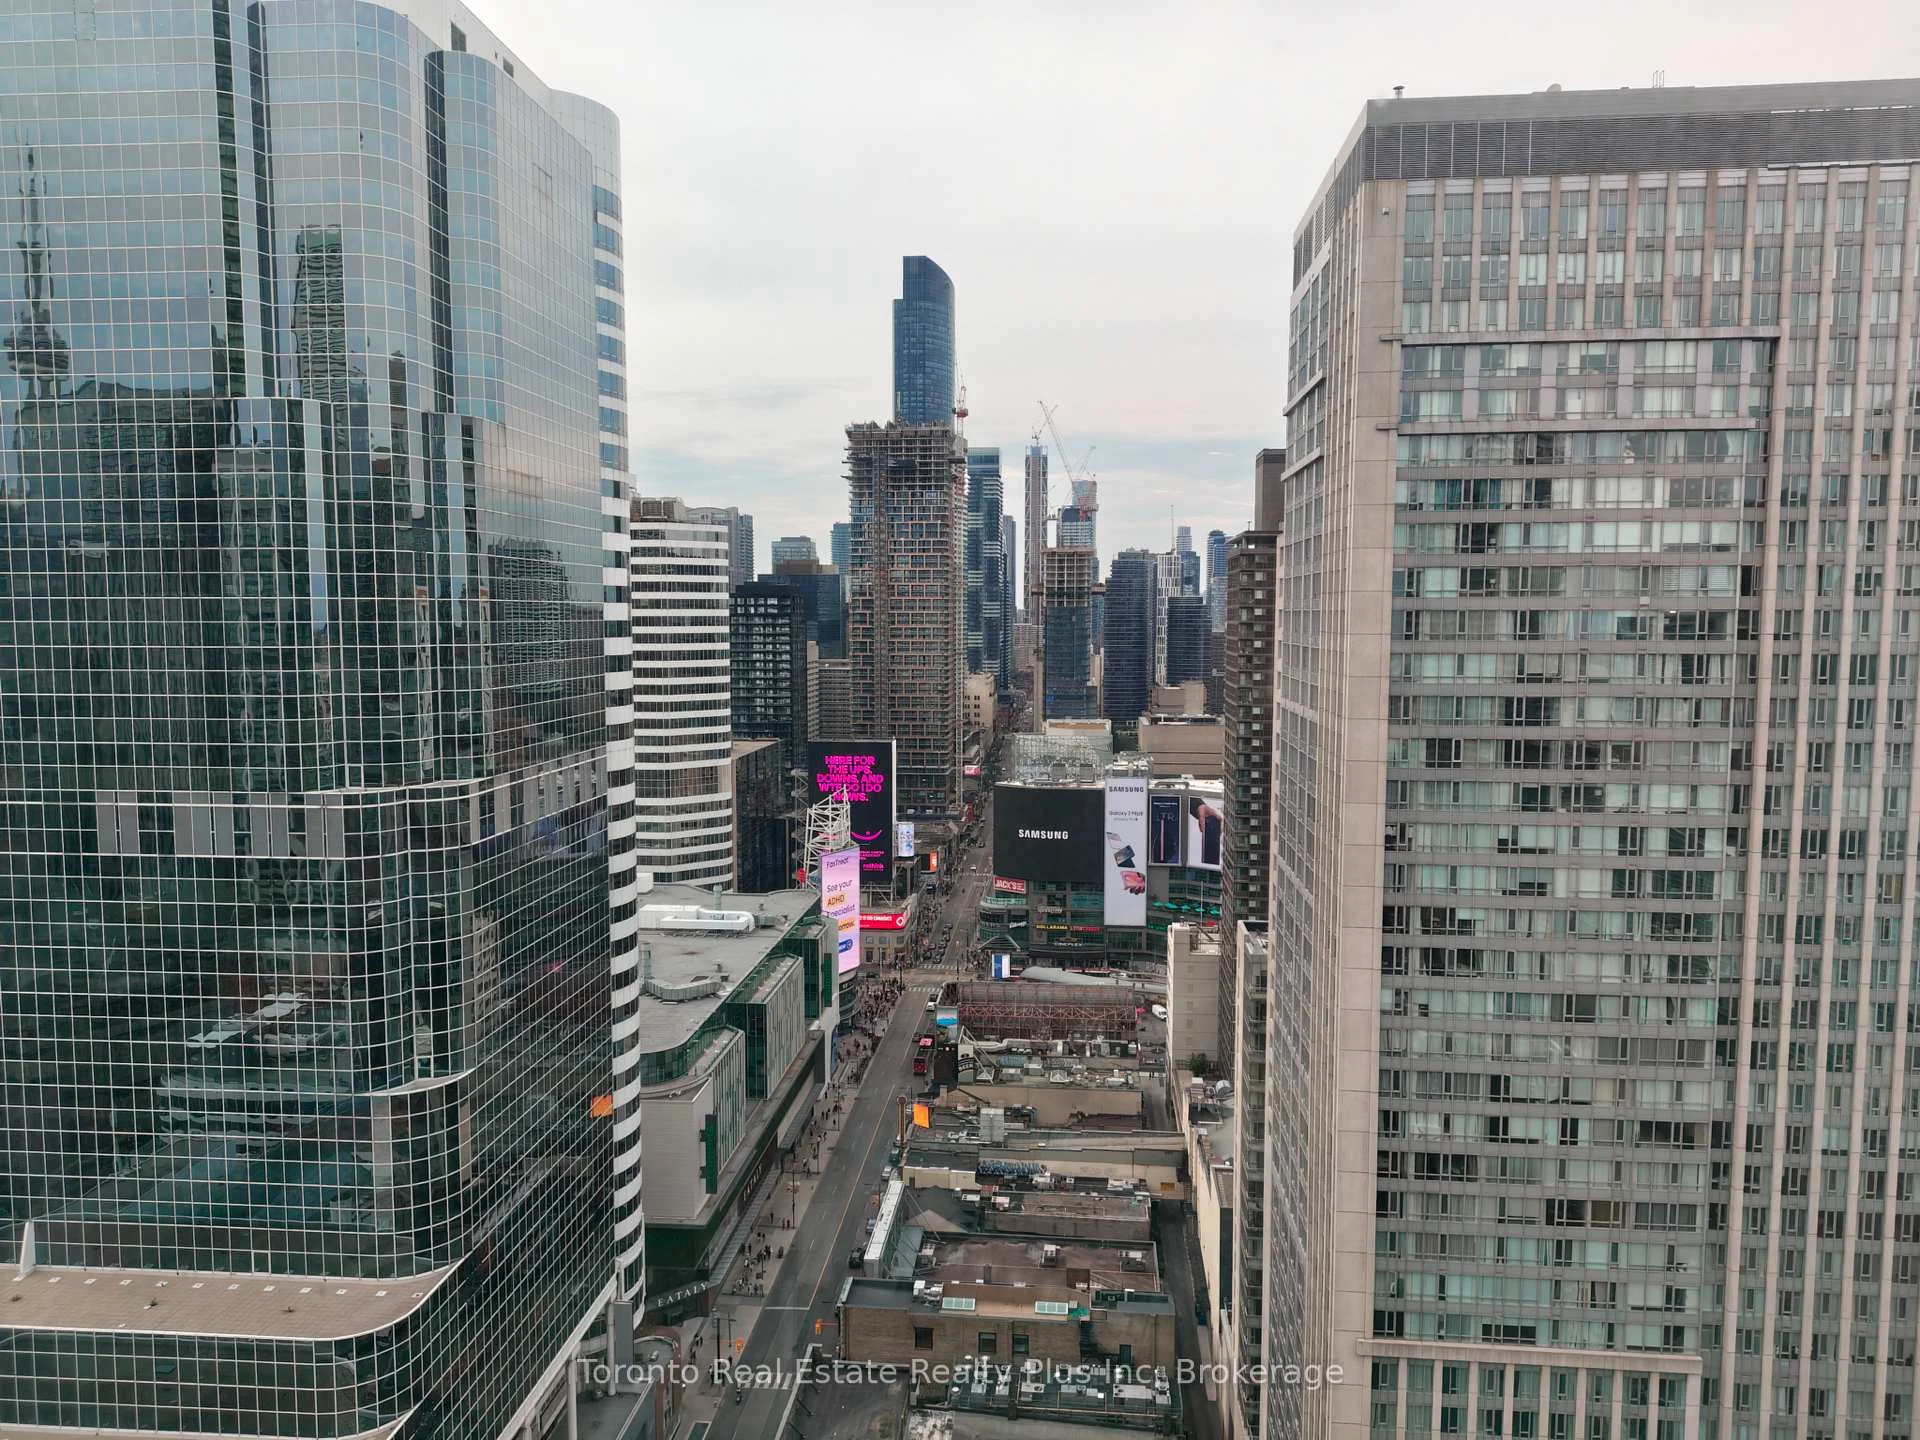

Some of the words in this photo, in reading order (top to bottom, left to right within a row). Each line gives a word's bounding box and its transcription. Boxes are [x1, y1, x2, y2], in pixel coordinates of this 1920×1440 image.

[825, 755, 853, 766] HERE
[853, 755, 876, 766] FOR
[827, 765, 849, 775] THE
[860, 774, 884, 784] AND
[865, 783, 882, 793] DO
[1018, 829, 1069, 840] SAMSUNG
[827, 883, 838, 893] See
[838, 880, 852, 892] your
[827, 894, 845, 906] ADHD
[657, 1282, 707, 1307] EATALY
